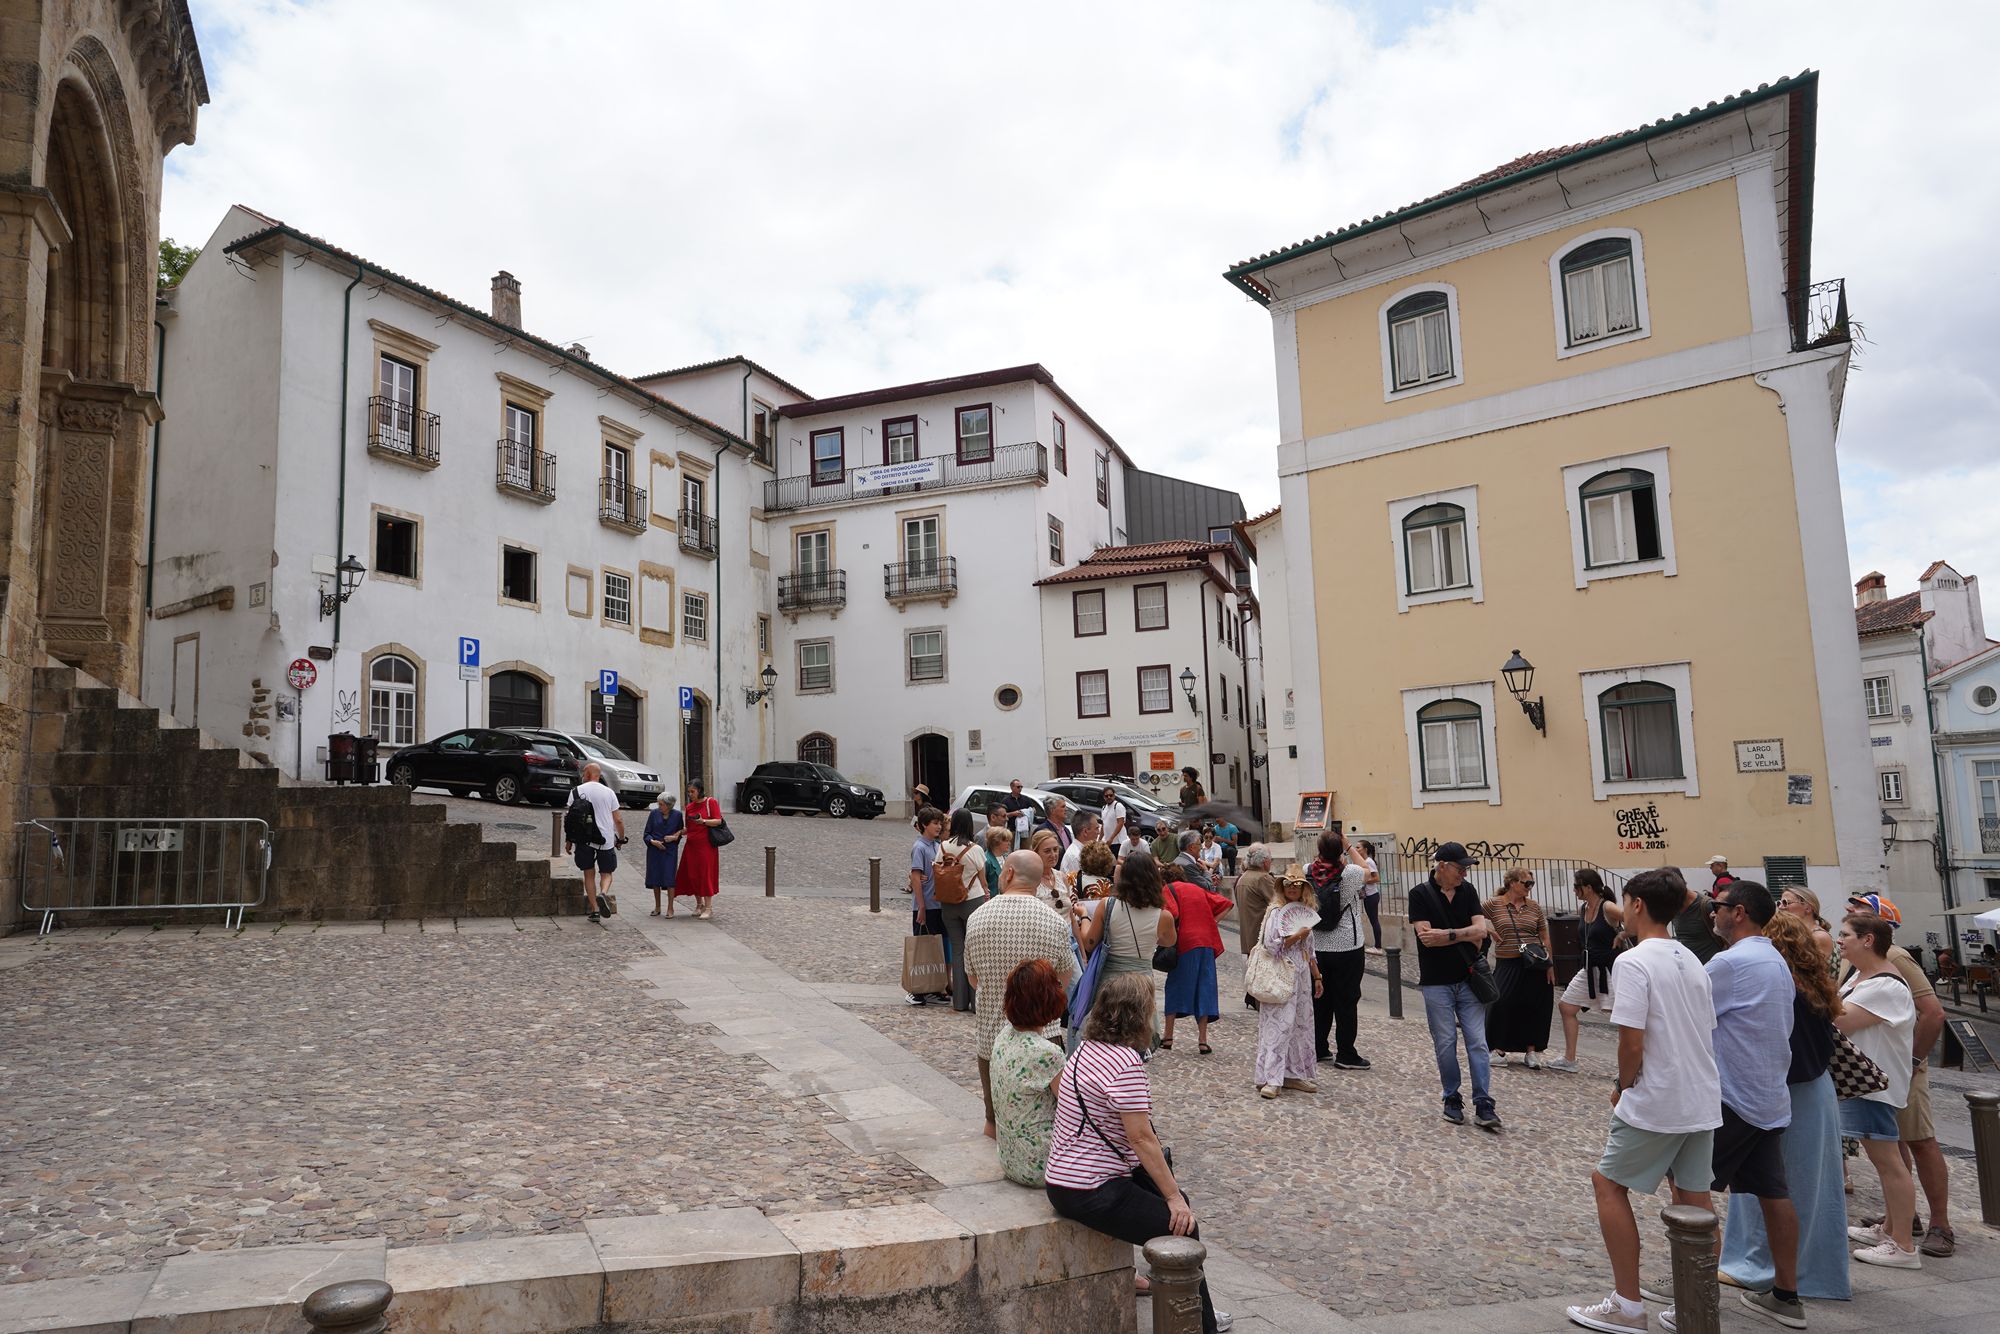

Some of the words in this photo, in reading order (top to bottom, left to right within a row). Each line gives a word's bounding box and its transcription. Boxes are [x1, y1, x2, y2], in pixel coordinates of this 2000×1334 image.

[890, 464, 918, 472] PROMOÇÃO
[464, 639, 476, 663] P
[603, 671, 615, 692] P
[681, 688, 691, 707] P
[1080, 738, 1106, 747] Antigas
[1616, 805, 1659, 824] GREVE
[1617, 819, 1665, 838] GERAL
[1619, 841, 1624, 849] 3
[1625, 841, 1645, 849] JUN.
[1645, 841, 1666, 849] 2026
